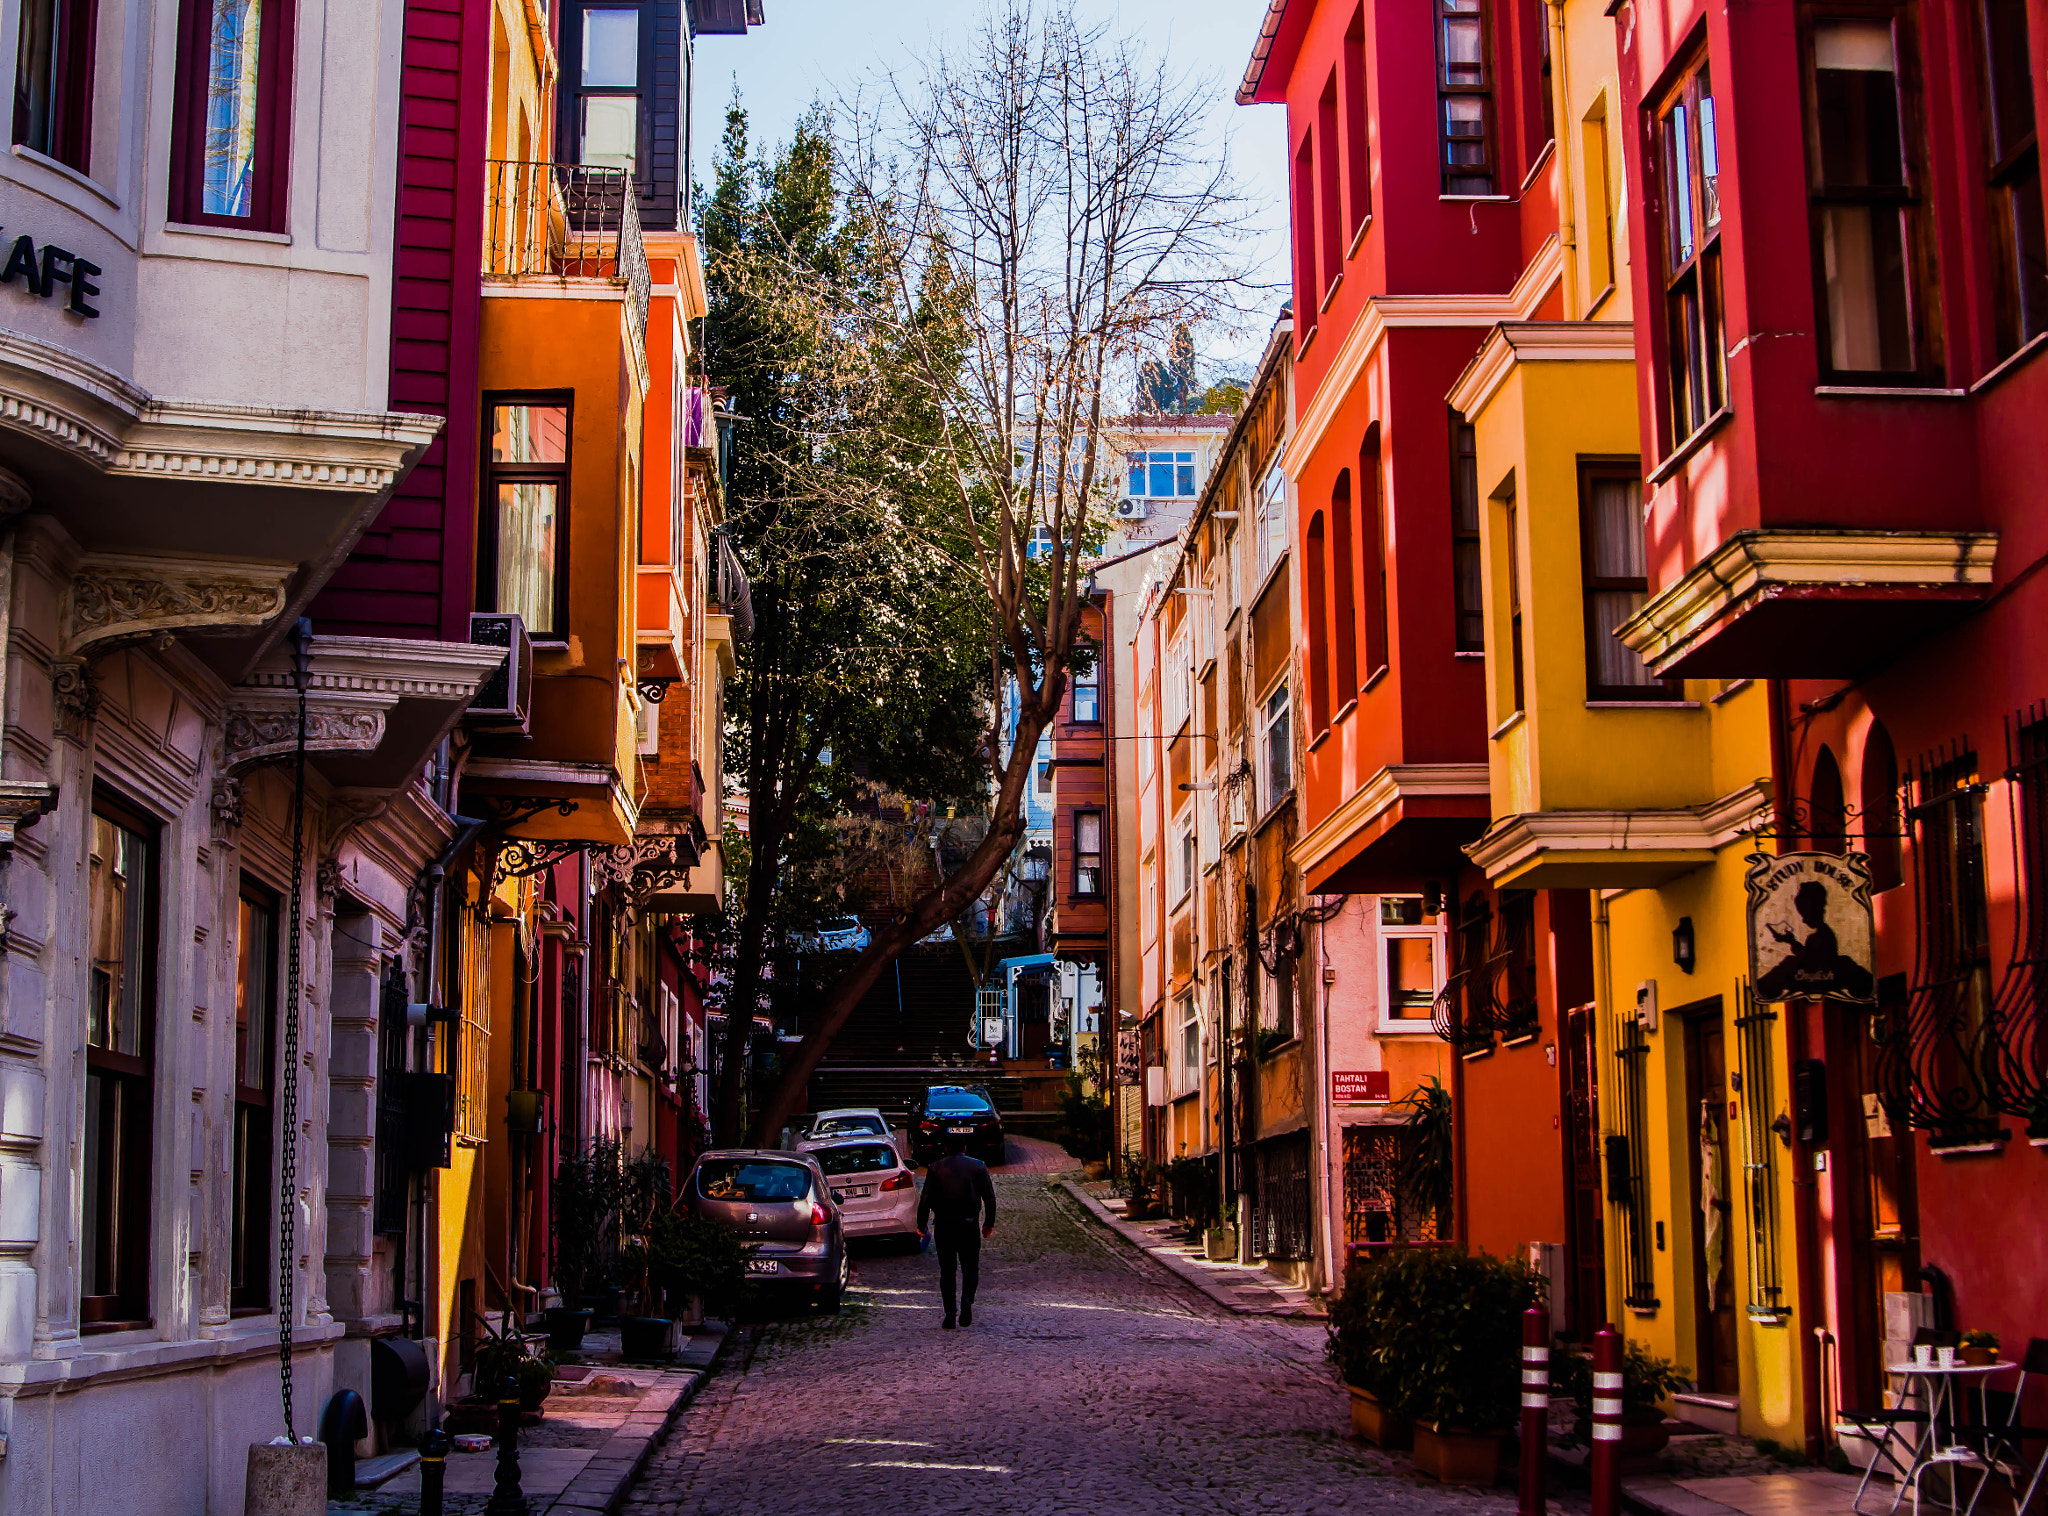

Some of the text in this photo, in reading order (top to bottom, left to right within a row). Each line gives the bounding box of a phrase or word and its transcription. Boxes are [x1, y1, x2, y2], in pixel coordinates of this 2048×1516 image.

[0, 227, 102, 318] AFE
[1766, 860, 1856, 892] STUDY HOUSE
[1120, 1038, 1135, 1050] NE
[1335, 1085, 1367, 1093] BOSTAN
